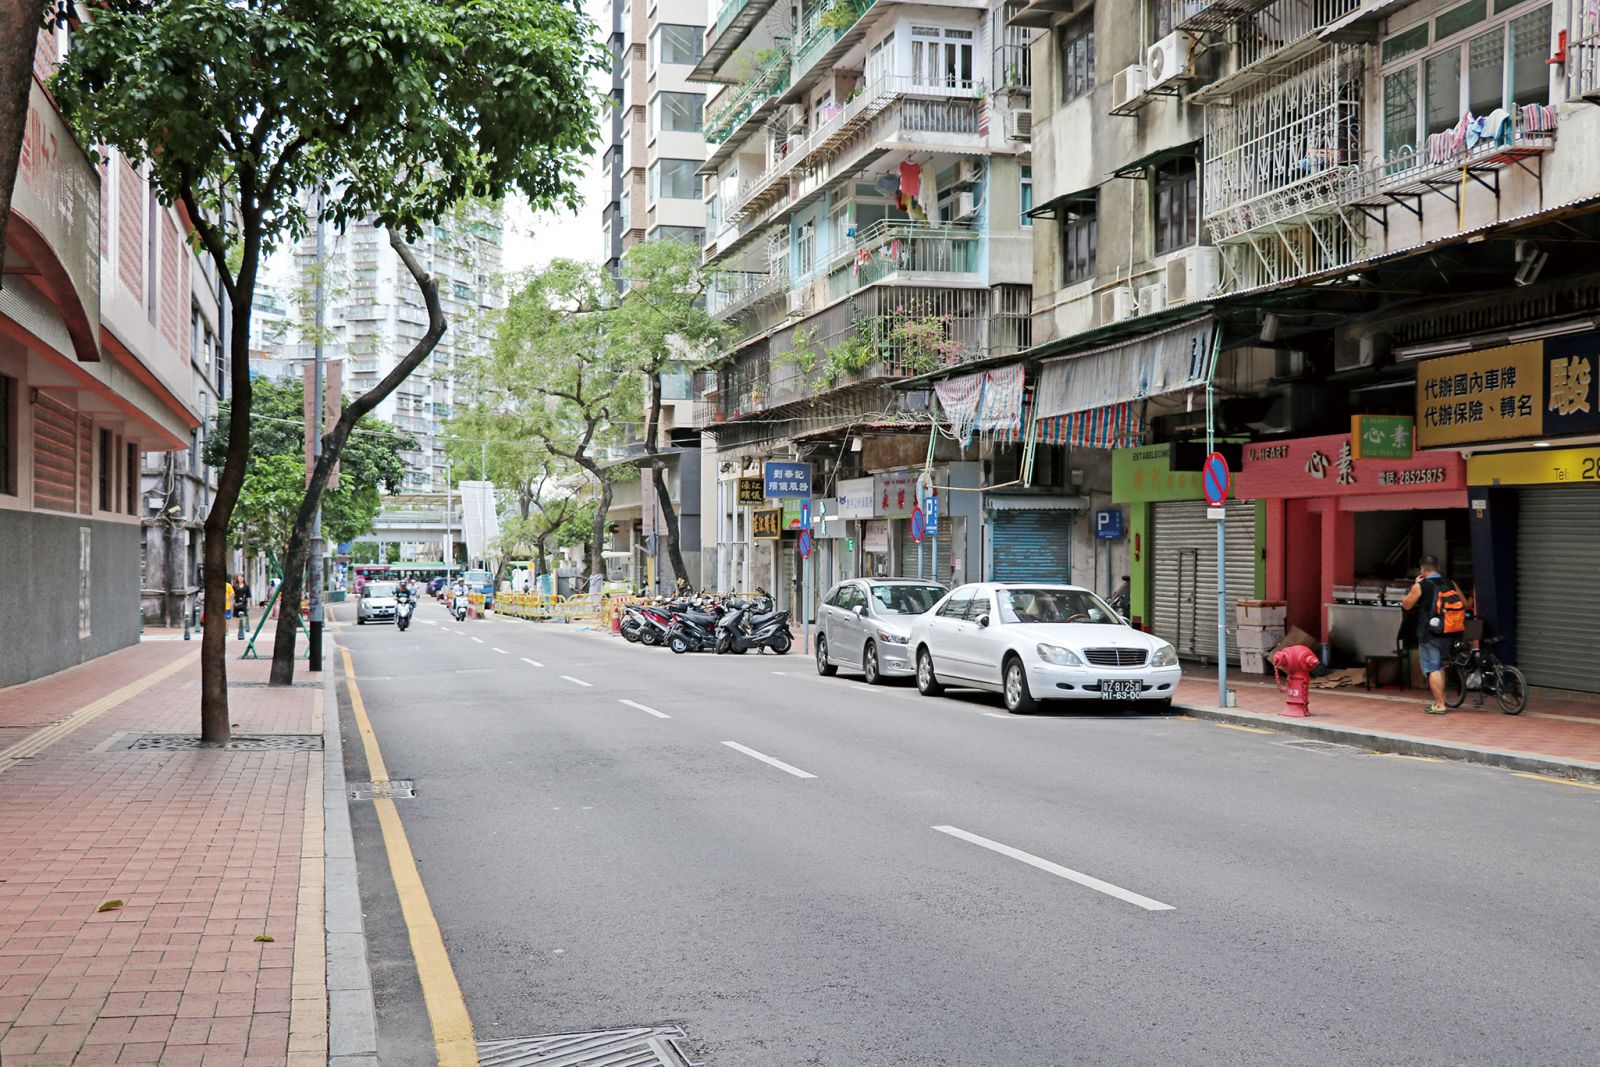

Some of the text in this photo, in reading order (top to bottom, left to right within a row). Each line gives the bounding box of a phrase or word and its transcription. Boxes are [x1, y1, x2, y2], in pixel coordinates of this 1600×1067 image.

[1424, 366, 1516, 400] 代辦國內車牌
[1549, 355, 1600, 416] 駿
[1424, 394, 1533, 428] 代辦保險、轉名
[1553, 468, 1568, 481] Tel:
[926, 499, 933, 525] P
[1098, 512, 1110, 531] P
[1102, 690, 1141, 700] MI-63-00
